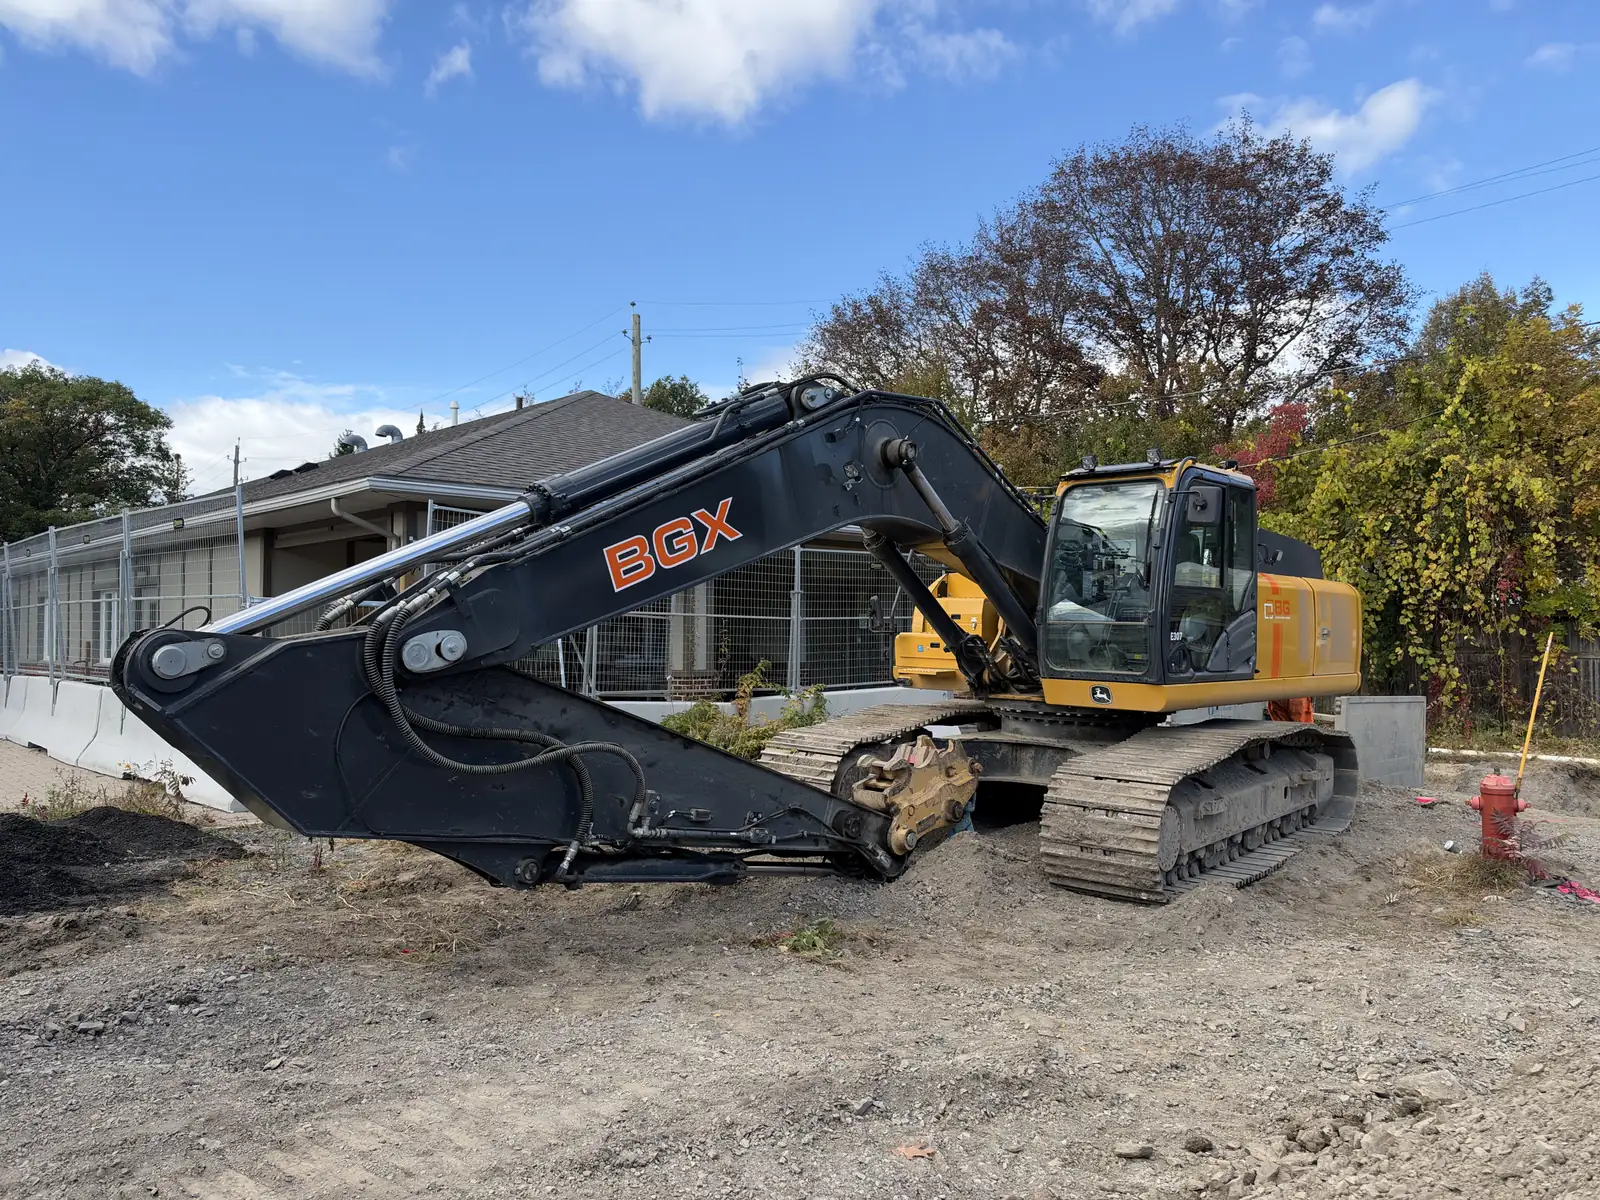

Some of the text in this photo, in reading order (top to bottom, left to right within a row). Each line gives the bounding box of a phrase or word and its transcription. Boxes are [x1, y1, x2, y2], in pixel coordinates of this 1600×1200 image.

[602, 496, 744, 593] BGX
[1274, 599, 1291, 616] BG
[1170, 631, 1183, 641] E307
